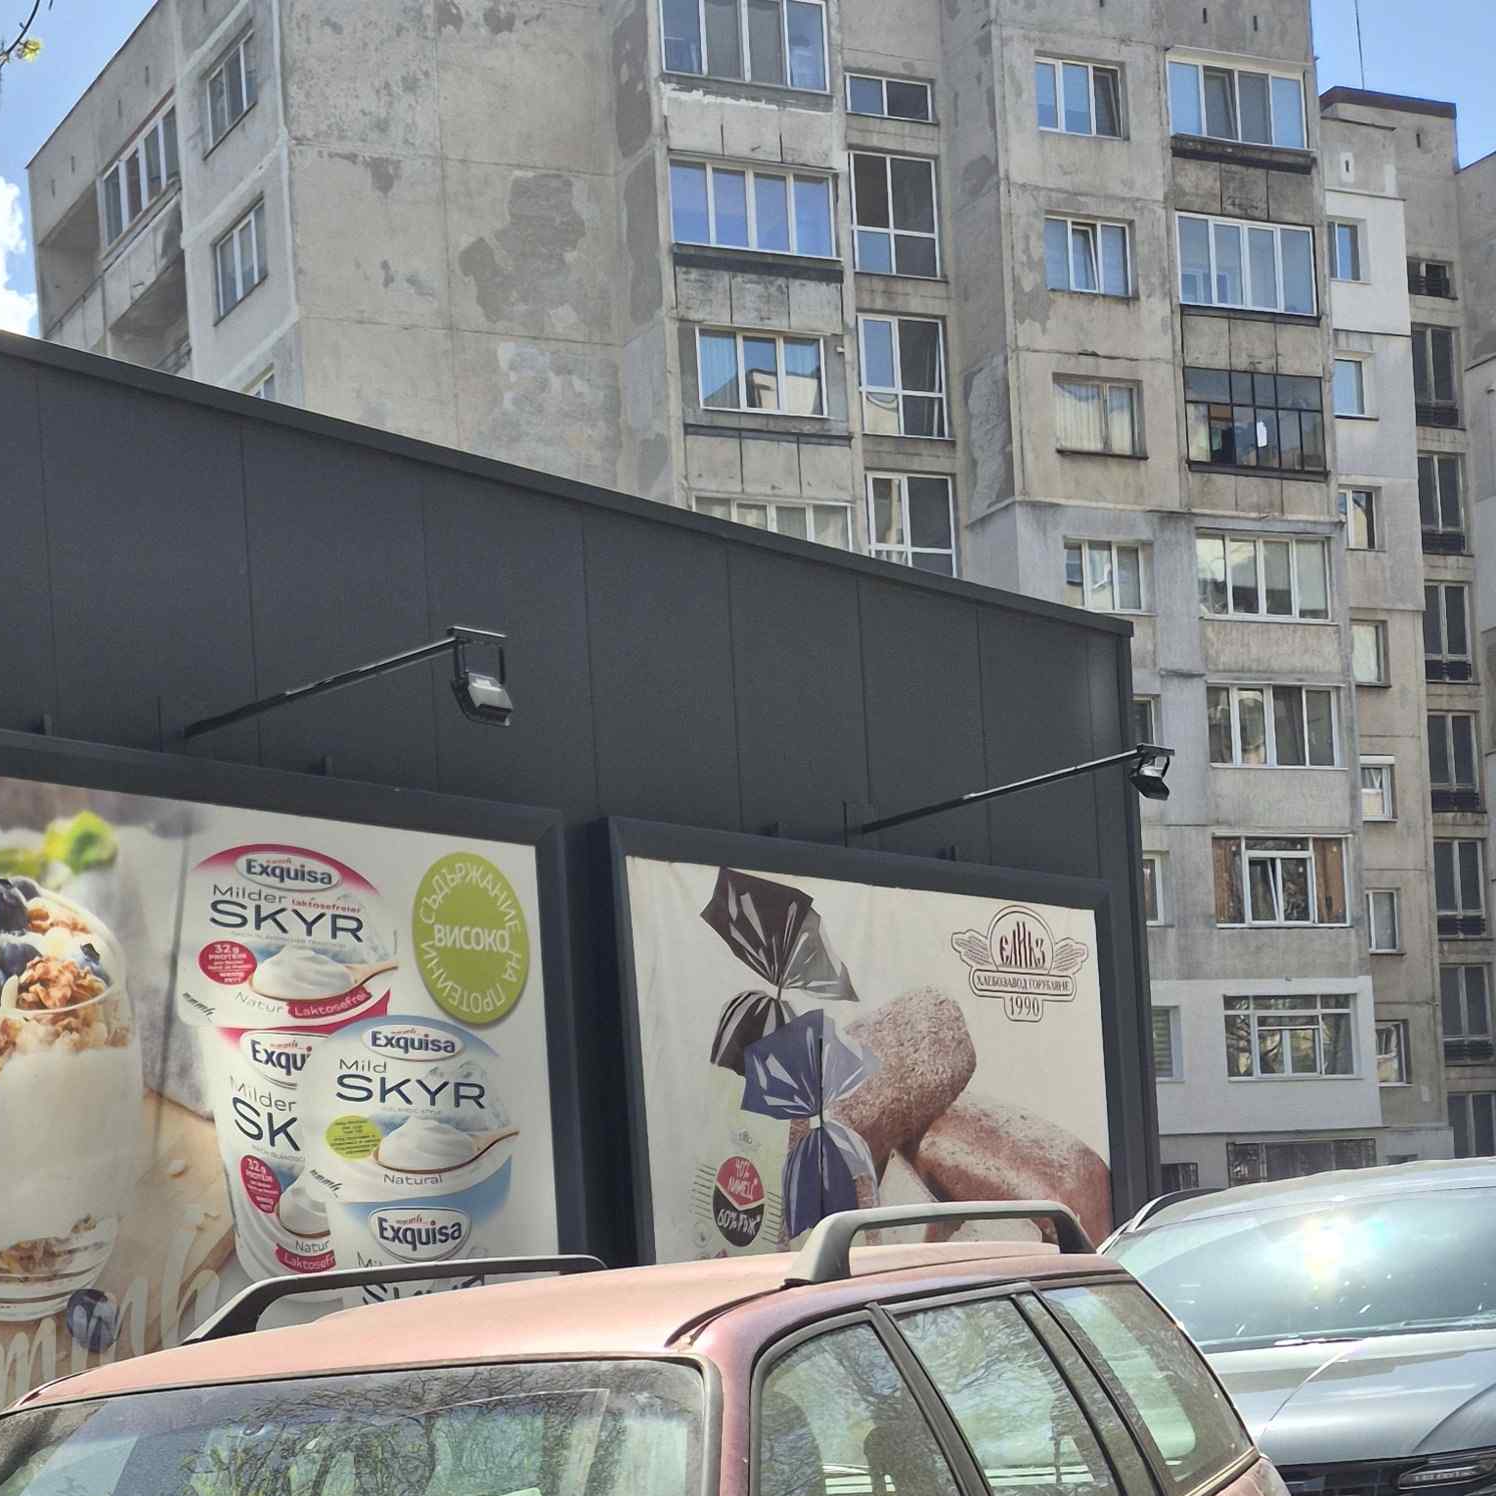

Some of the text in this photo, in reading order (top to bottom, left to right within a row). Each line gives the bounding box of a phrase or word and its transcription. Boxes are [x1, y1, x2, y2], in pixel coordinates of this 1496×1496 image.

[246, 858, 332, 885] Exquisa
[213, 884, 287, 904] Milder
[209, 900, 364, 943] SKYR
[434, 924, 509, 953] ВИСОКО
[234, 991, 283, 1013] Natur
[1010, 996, 1040, 1016] 1990
[371, 1031, 456, 1054] Exquisa
[339, 1058, 387, 1074] Mild
[336, 1073, 485, 1109] SKYR
[232, 1096, 300, 1152] SK
[383, 1174, 443, 1185] Natural
[377, 1217, 462, 1251] Exquisa
